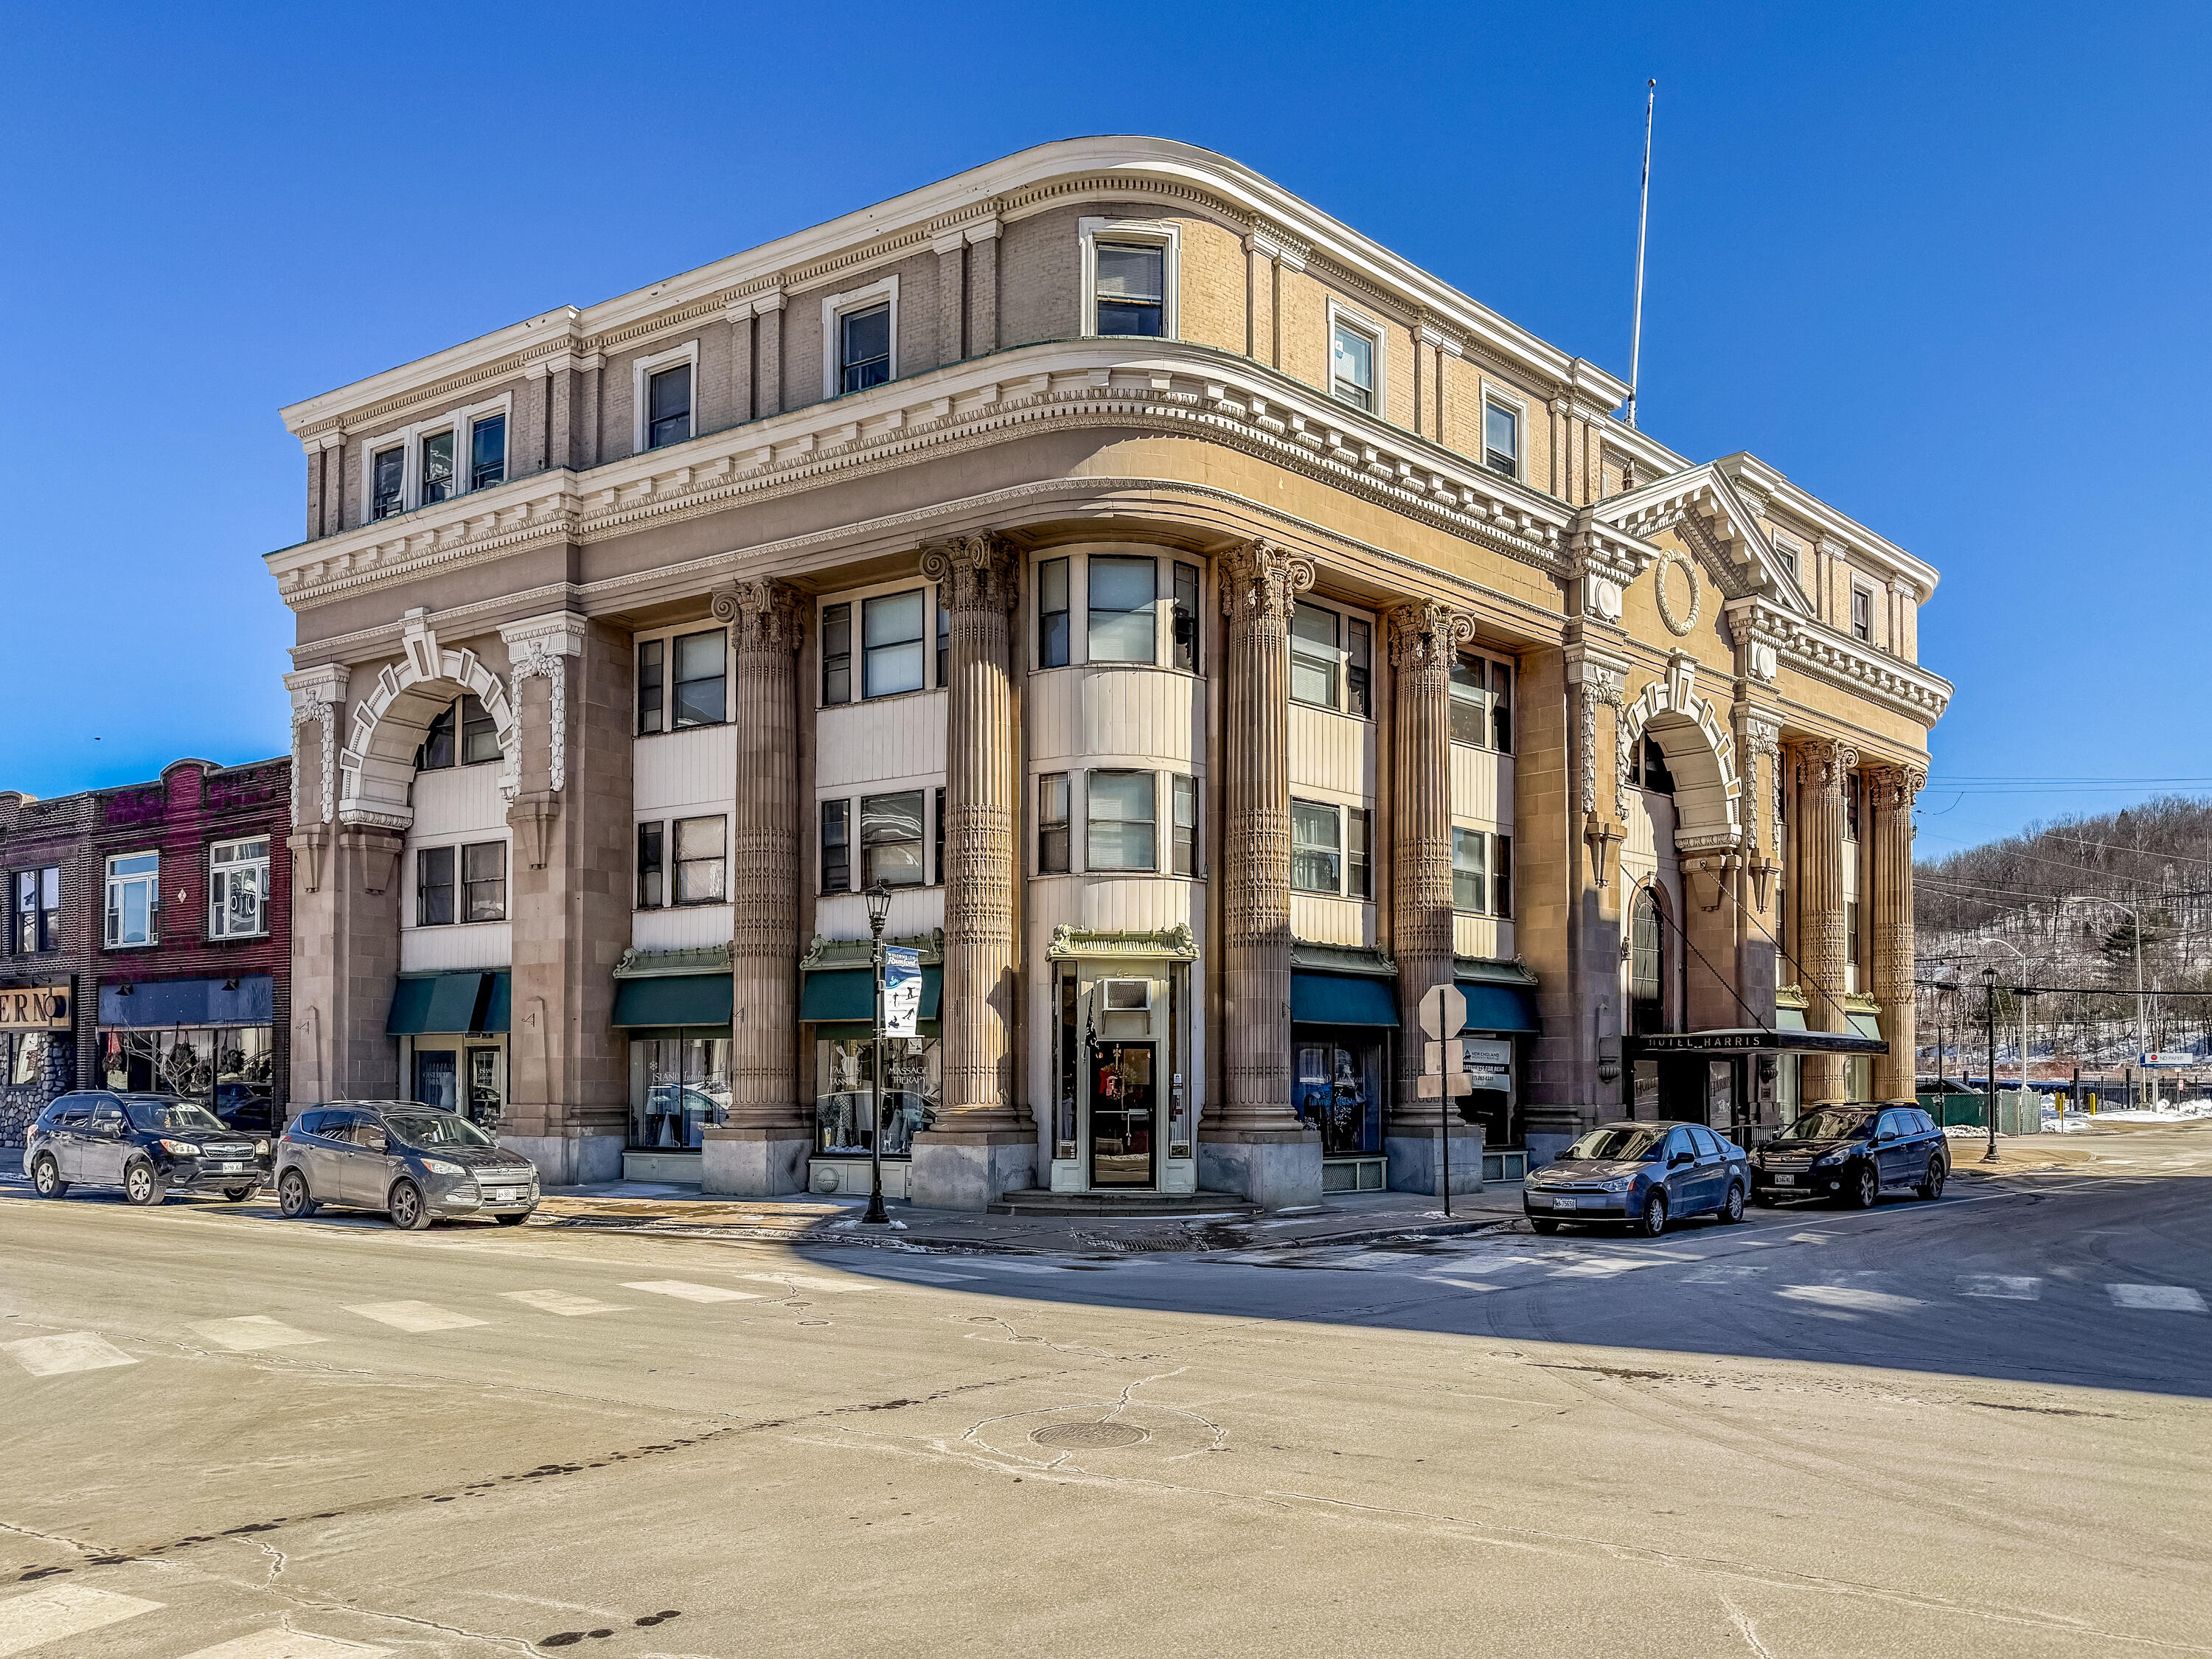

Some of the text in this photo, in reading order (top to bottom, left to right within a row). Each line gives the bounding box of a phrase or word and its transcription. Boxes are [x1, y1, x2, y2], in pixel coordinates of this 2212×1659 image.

[887, 957, 917, 967] Rumford
[1704, 1037, 1760, 1046] HARRIS
[888, 1066, 929, 1075] MASSAGE
[891, 1076, 927, 1085] THERAPY
